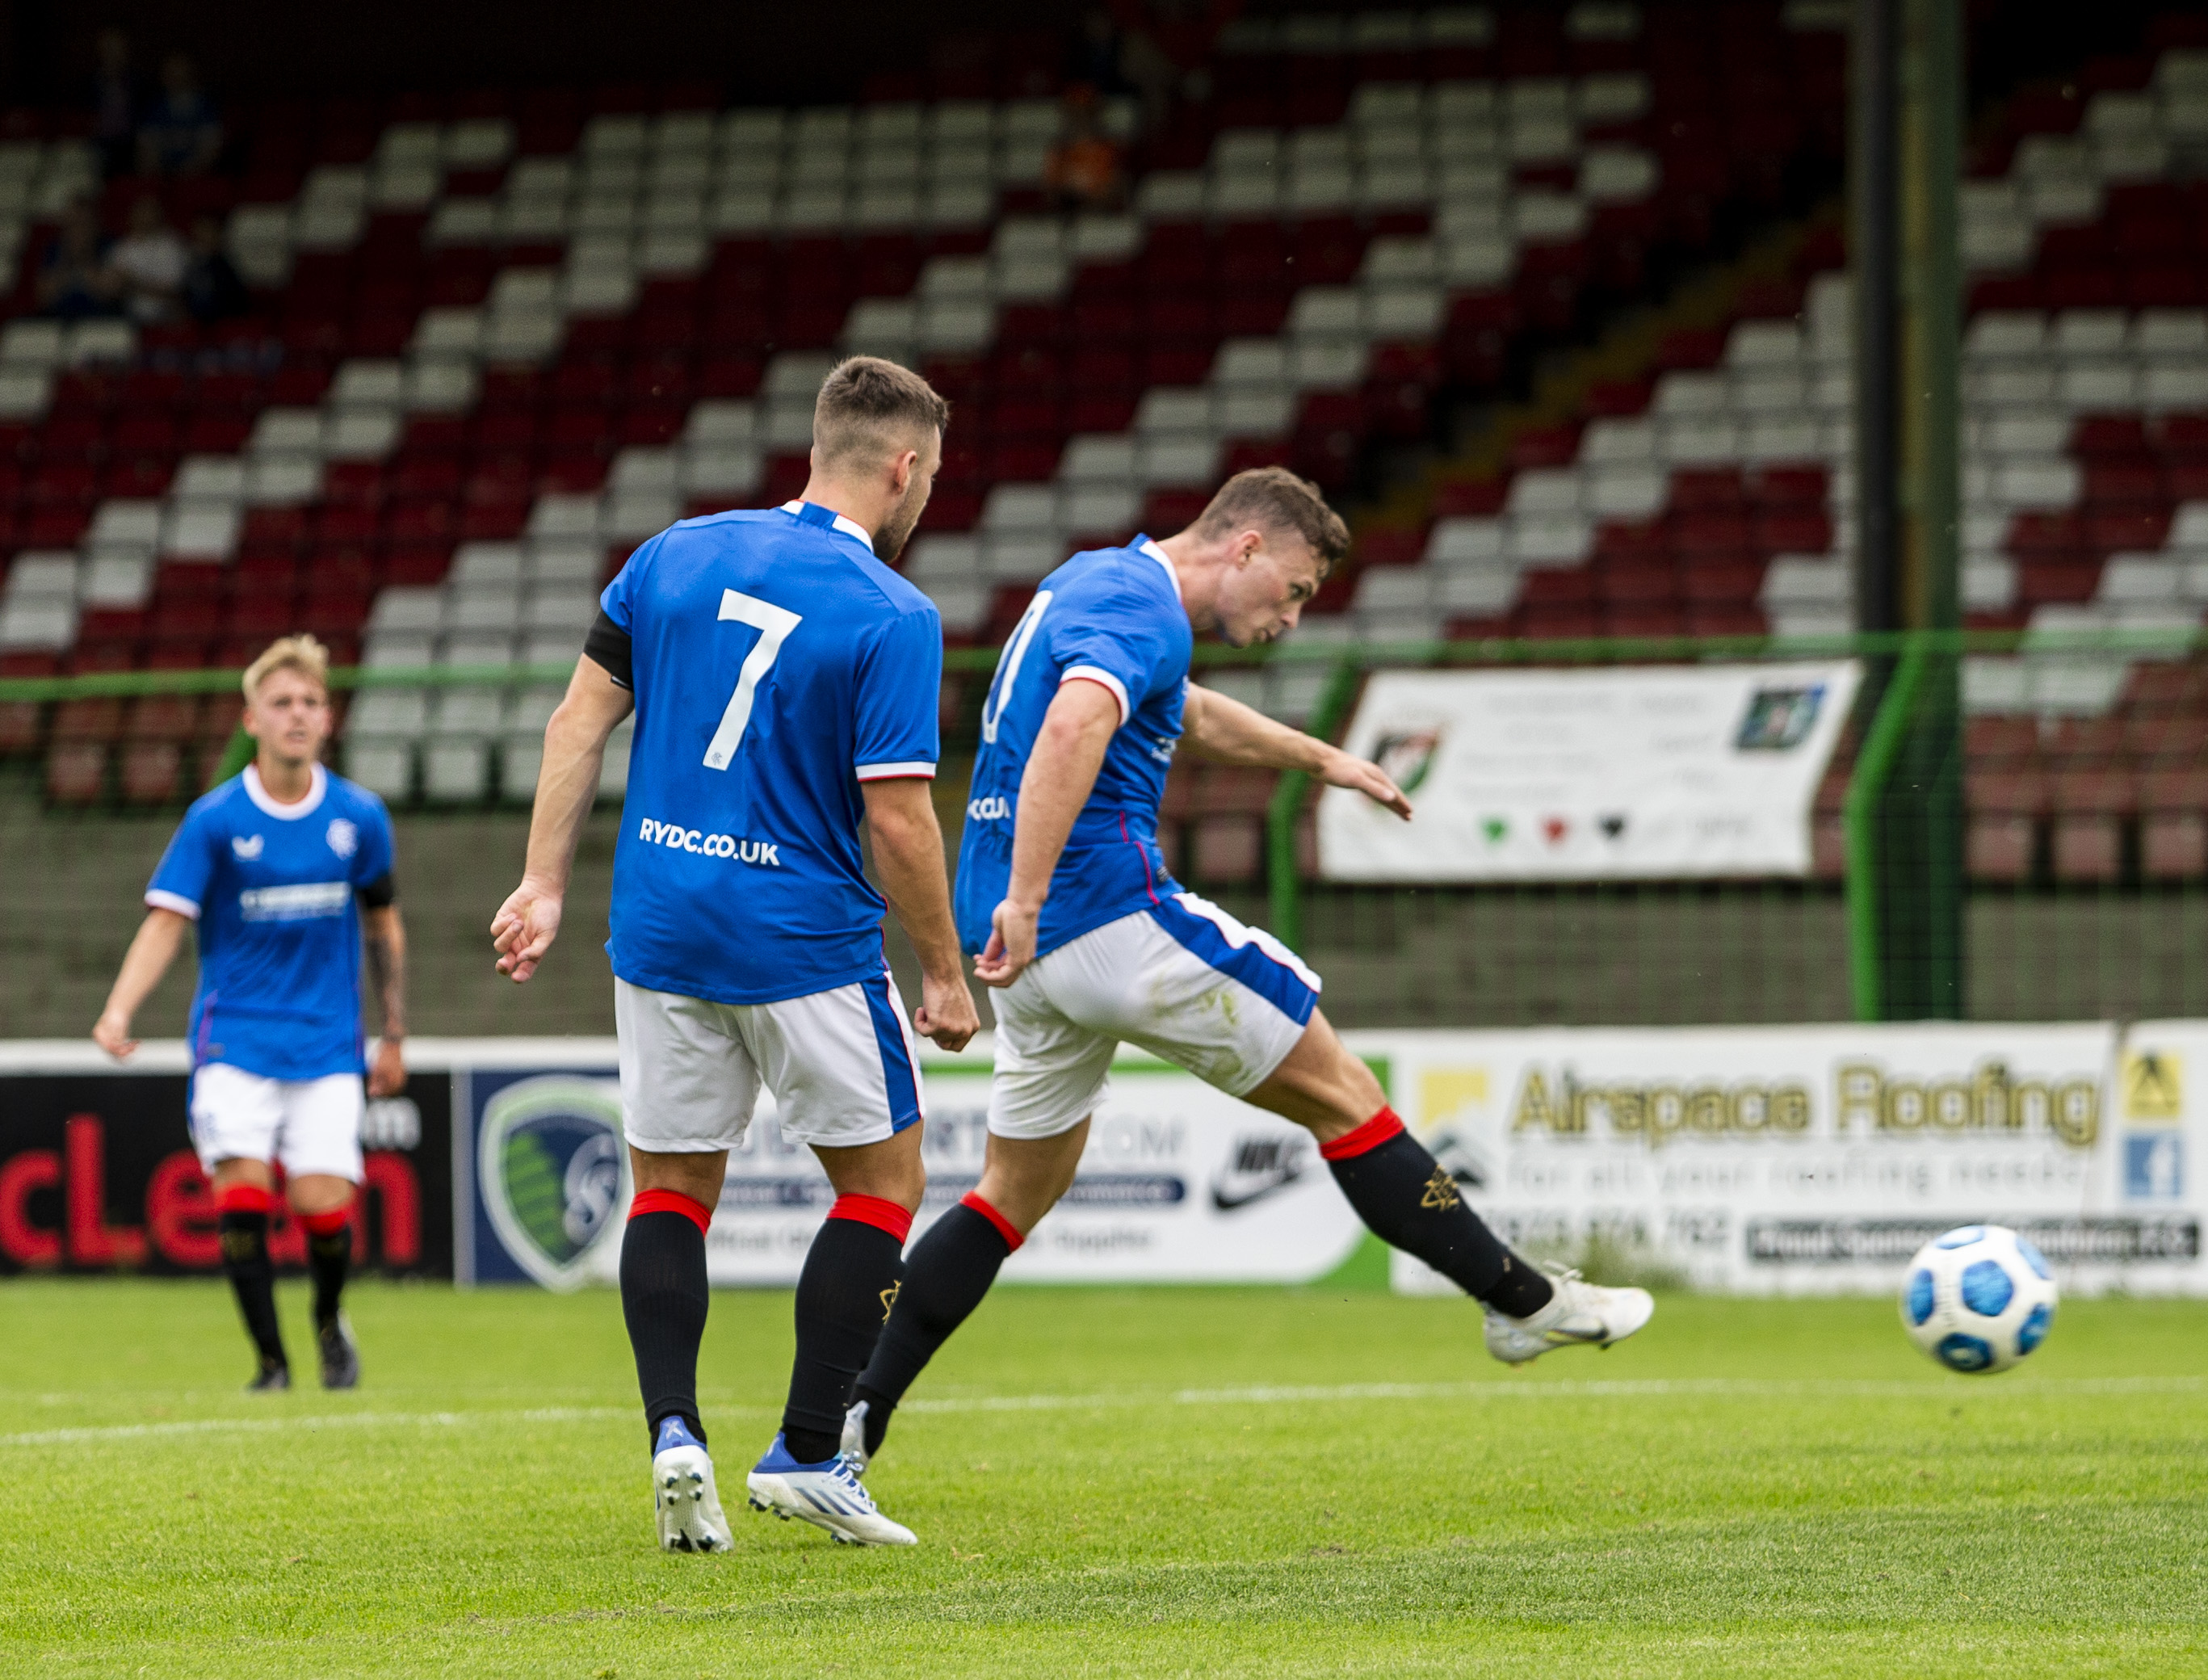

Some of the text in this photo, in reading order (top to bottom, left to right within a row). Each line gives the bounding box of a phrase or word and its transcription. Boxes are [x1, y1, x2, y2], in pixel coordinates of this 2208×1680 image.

[703, 588, 803, 771] 7
[639, 817, 780, 866] RYDC.CO.UK
[1509, 1056, 2098, 1151] Airspace Roofing
